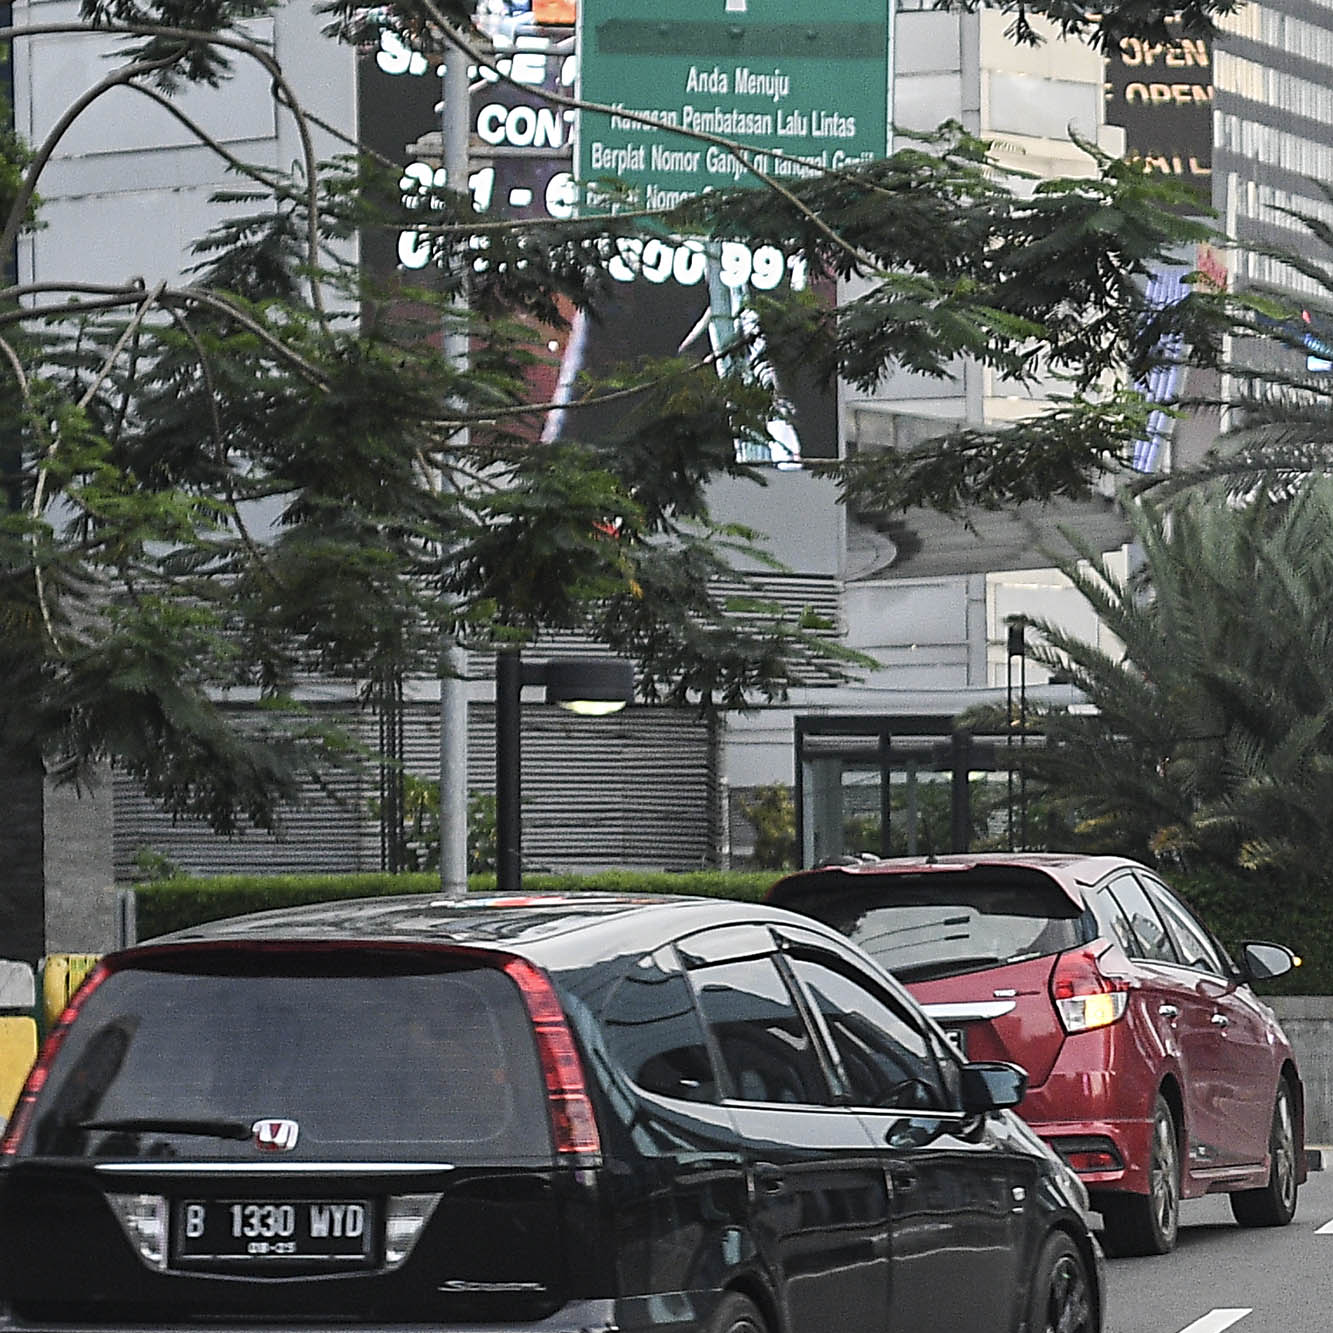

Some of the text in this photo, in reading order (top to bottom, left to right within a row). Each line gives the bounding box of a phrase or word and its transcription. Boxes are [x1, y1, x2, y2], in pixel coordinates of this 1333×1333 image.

[686, 66, 789, 102] Anda Menuju
[683, 106, 772, 135] Pembatasan
[777, 110, 807, 137] Lalu
[812, 111, 856, 137] Lintas
[591, 142, 645, 176] Berplat
[651, 144, 700, 173] Nomor
[186, 1205, 365, 1238] B 1330 WYD
